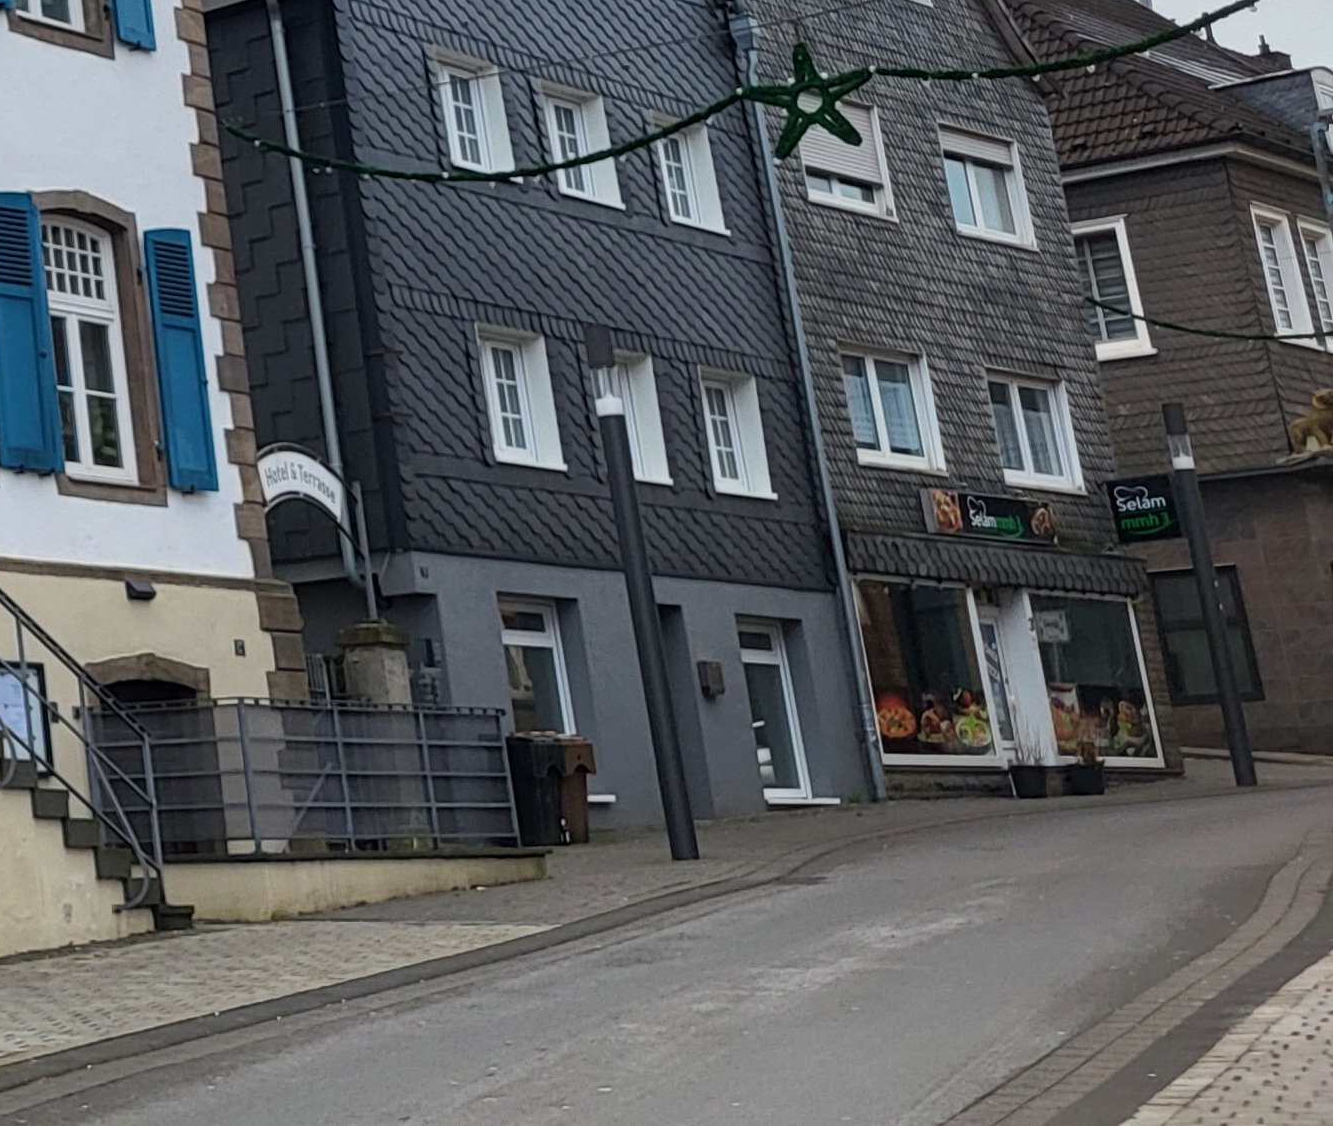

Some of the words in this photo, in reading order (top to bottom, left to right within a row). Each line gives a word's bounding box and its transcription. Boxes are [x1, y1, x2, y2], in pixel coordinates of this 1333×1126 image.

[265, 461, 289, 488] Hotel
[297, 463, 335, 504] Terrasse
[1116, 496, 1166, 512] Selam
